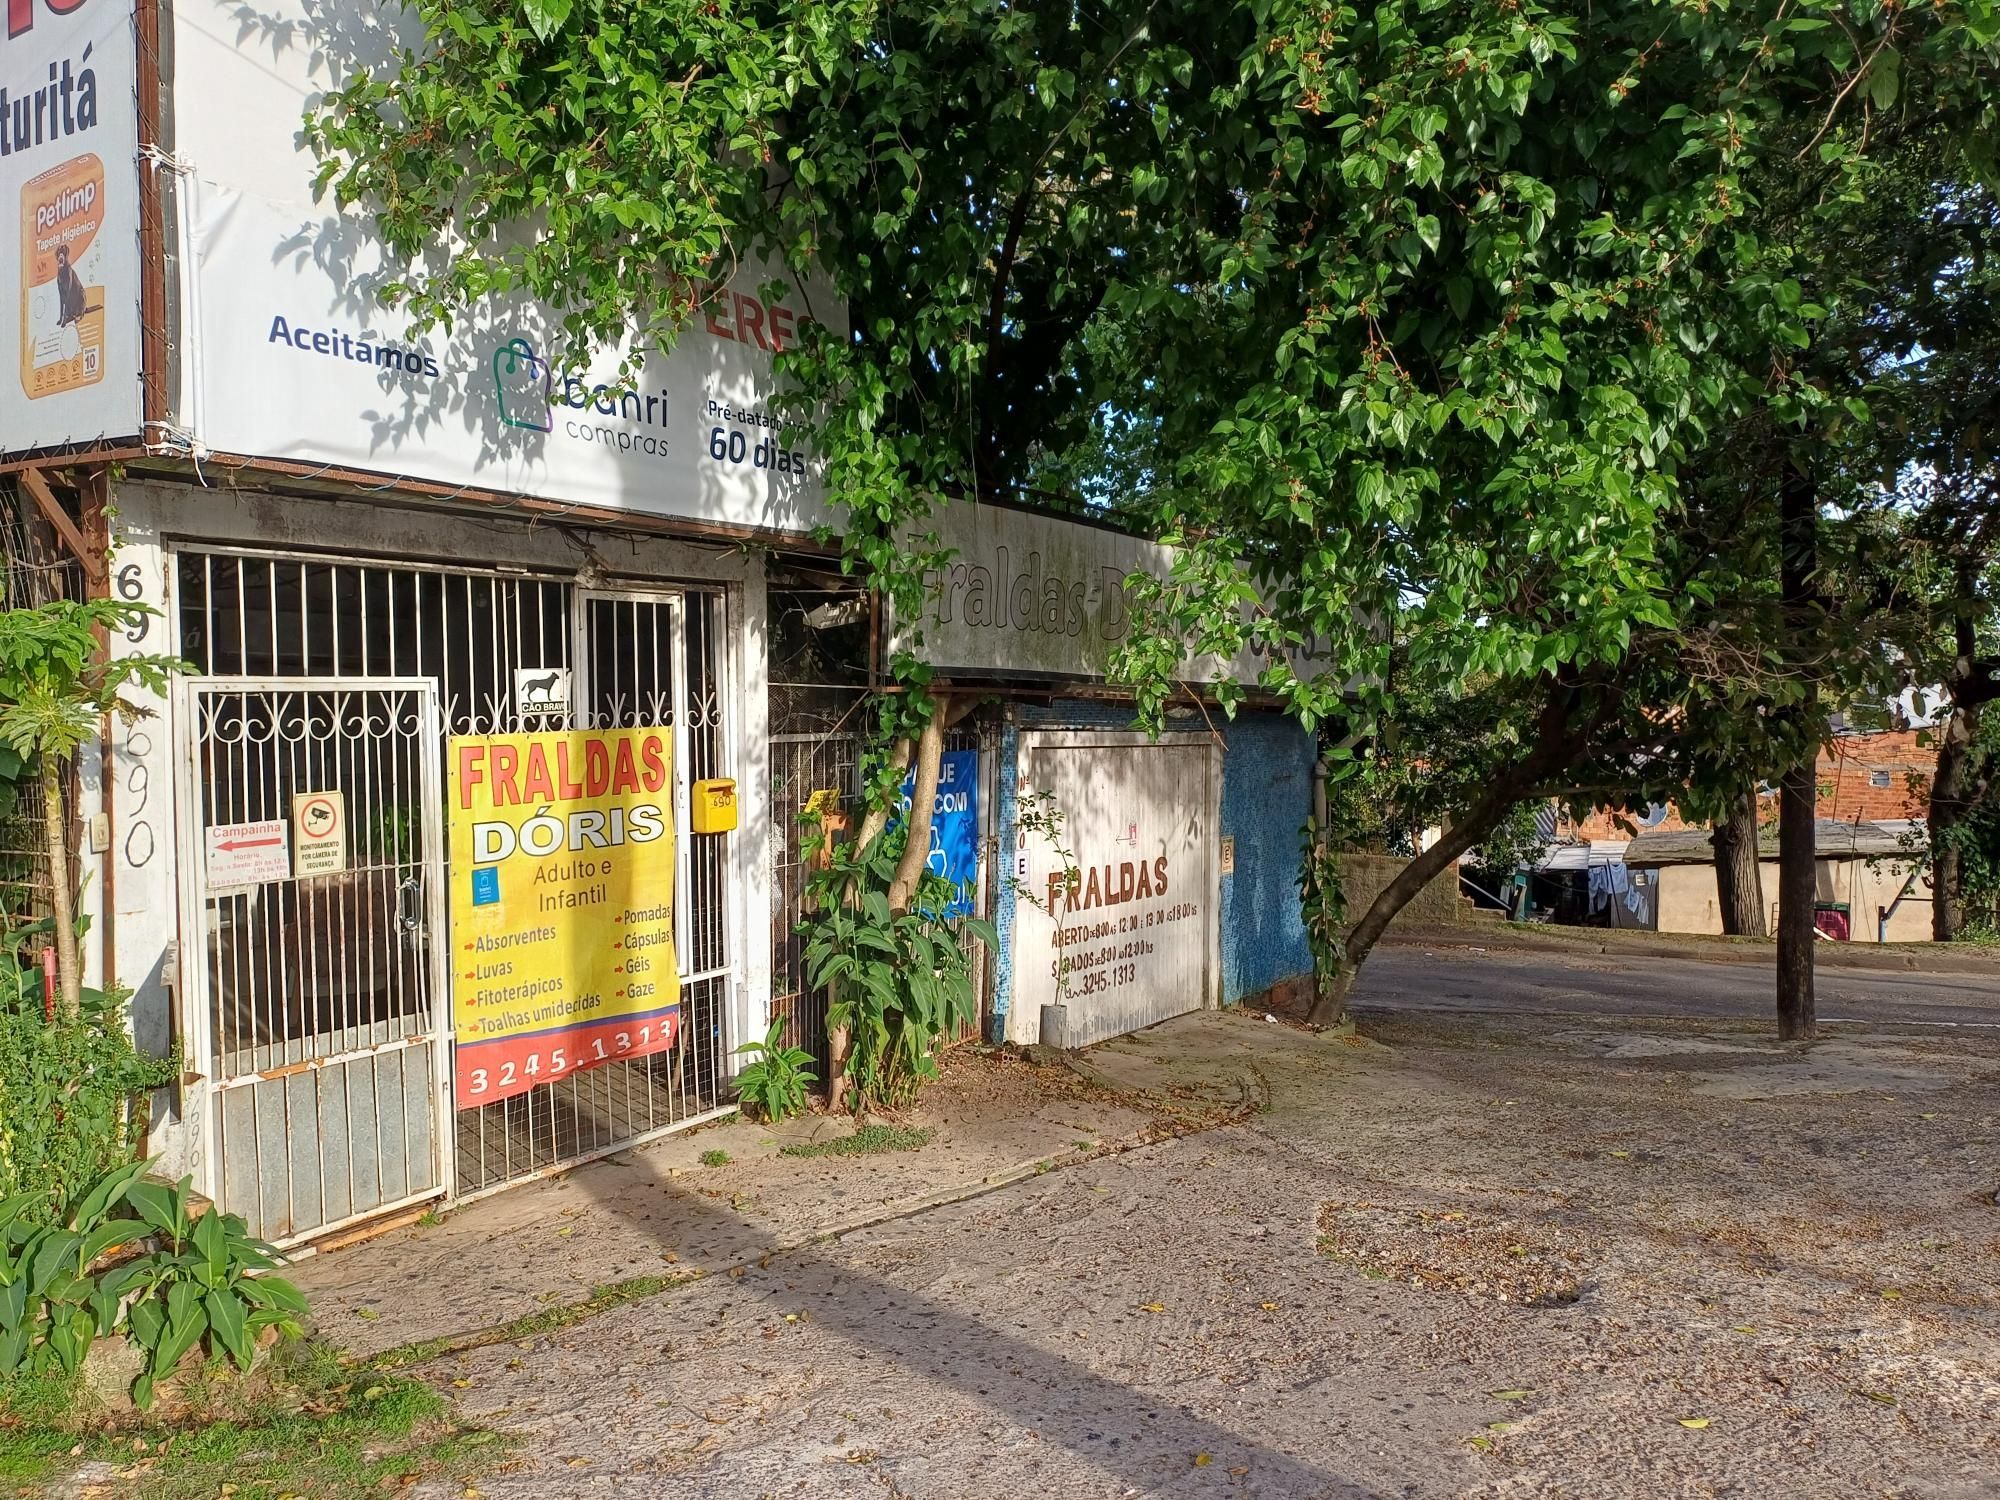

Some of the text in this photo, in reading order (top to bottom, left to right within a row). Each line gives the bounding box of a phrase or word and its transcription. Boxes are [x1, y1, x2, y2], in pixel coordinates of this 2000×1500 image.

[36, 180, 97, 235] Petlimp
[269, 315, 439, 378] Aceitamos
[84, 353, 96, 370] 10
[561, 364, 668, 428] banri
[566, 421, 669, 457] compras
[710, 427, 805, 475] 60 dias
[459, 735, 666, 810] FRALDAS
[934, 791, 968, 815] COM
[213, 823, 281, 838] Campainha
[472, 804, 665, 865] DÓRIS
[300, 840, 340, 851] MONITORAMENTO
[301, 853, 312, 861] POR
[312, 851, 331, 860] CÂMERA
[306, 860, 335, 870] SEGURANÇA
[534, 860, 612, 885] Adulto e
[539, 884, 607, 912] Infantil
[1048, 856, 1169, 917] FRALDAS
[624, 903, 671, 926] Pomadas
[475, 926, 557, 953] Absorventes
[624, 928, 670, 951] Cápsulas
[1052, 925, 1090, 949] ABERTO
[476, 961, 513, 981] Luvas
[626, 956, 650, 974] Géis
[1052, 951, 1094, 978] SBADOS
[477, 977, 563, 1008] Fitoterápicos
[627, 982, 655, 999] Gaze
[1083, 962, 1136, 996] 3245.1313
[478, 993, 601, 1034] Toalhas umidecidas
